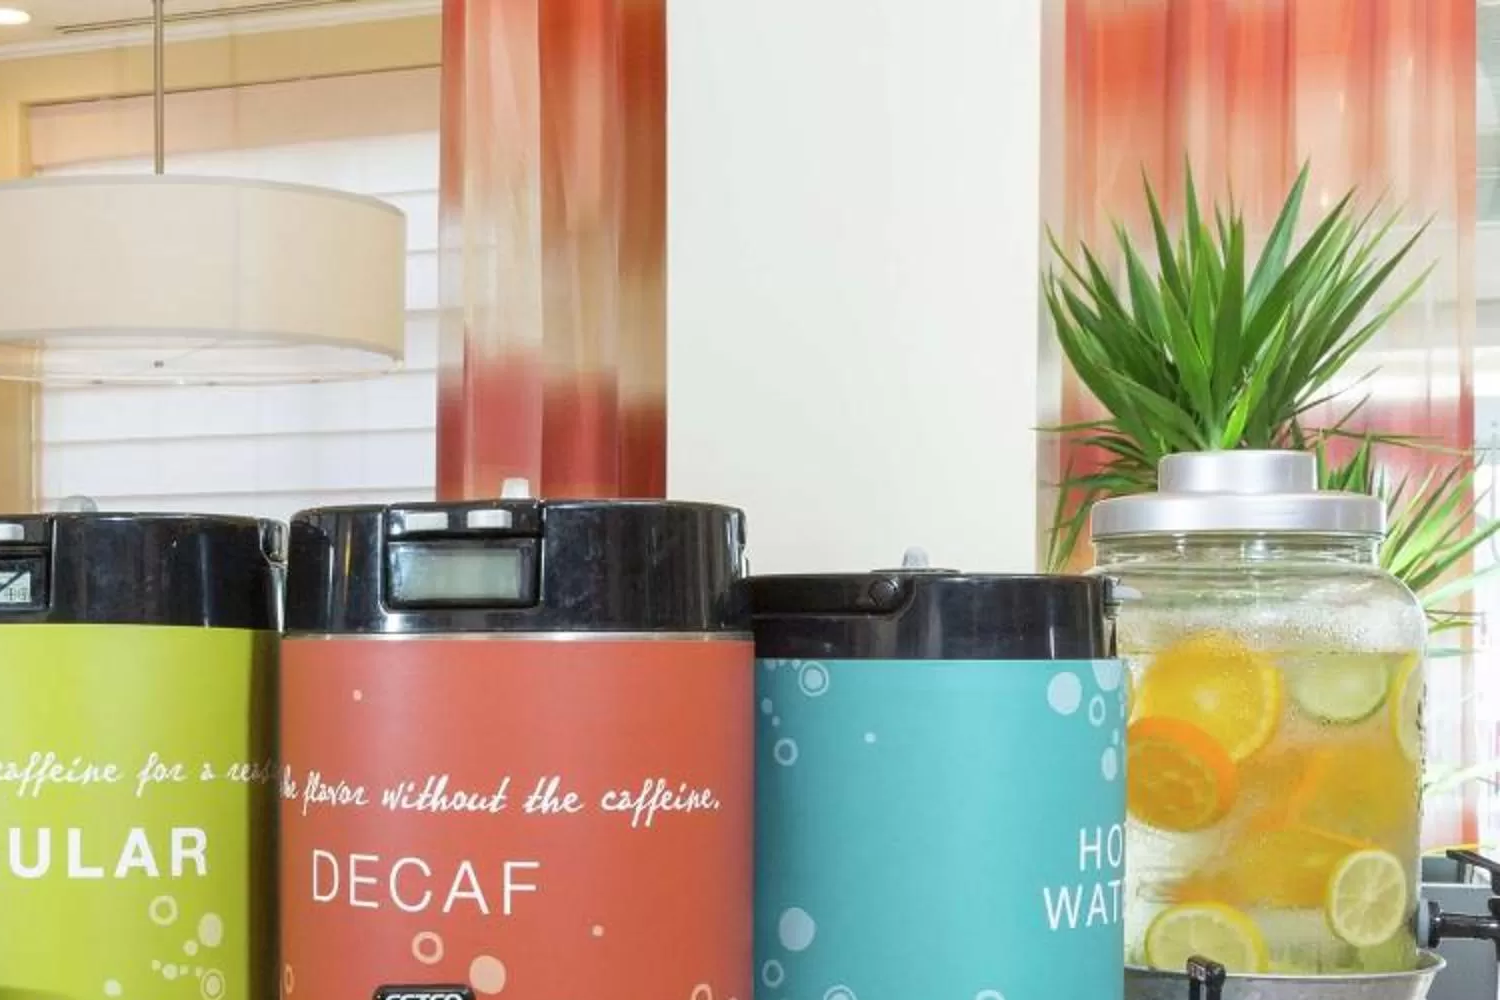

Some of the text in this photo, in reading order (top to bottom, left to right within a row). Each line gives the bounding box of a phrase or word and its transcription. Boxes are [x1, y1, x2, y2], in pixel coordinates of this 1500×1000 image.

[135, 751, 188, 799] for
[199, 761, 216, 782] a
[301, 768, 369, 817] flavor
[380, 774, 511, 815] without
[523, 775, 584, 815] the
[600, 778, 722, 828] caffeine.
[1079, 823, 1123, 872] HO
[312, 848, 540, 916] DECAF
[1042, 880, 1122, 931] WAT
